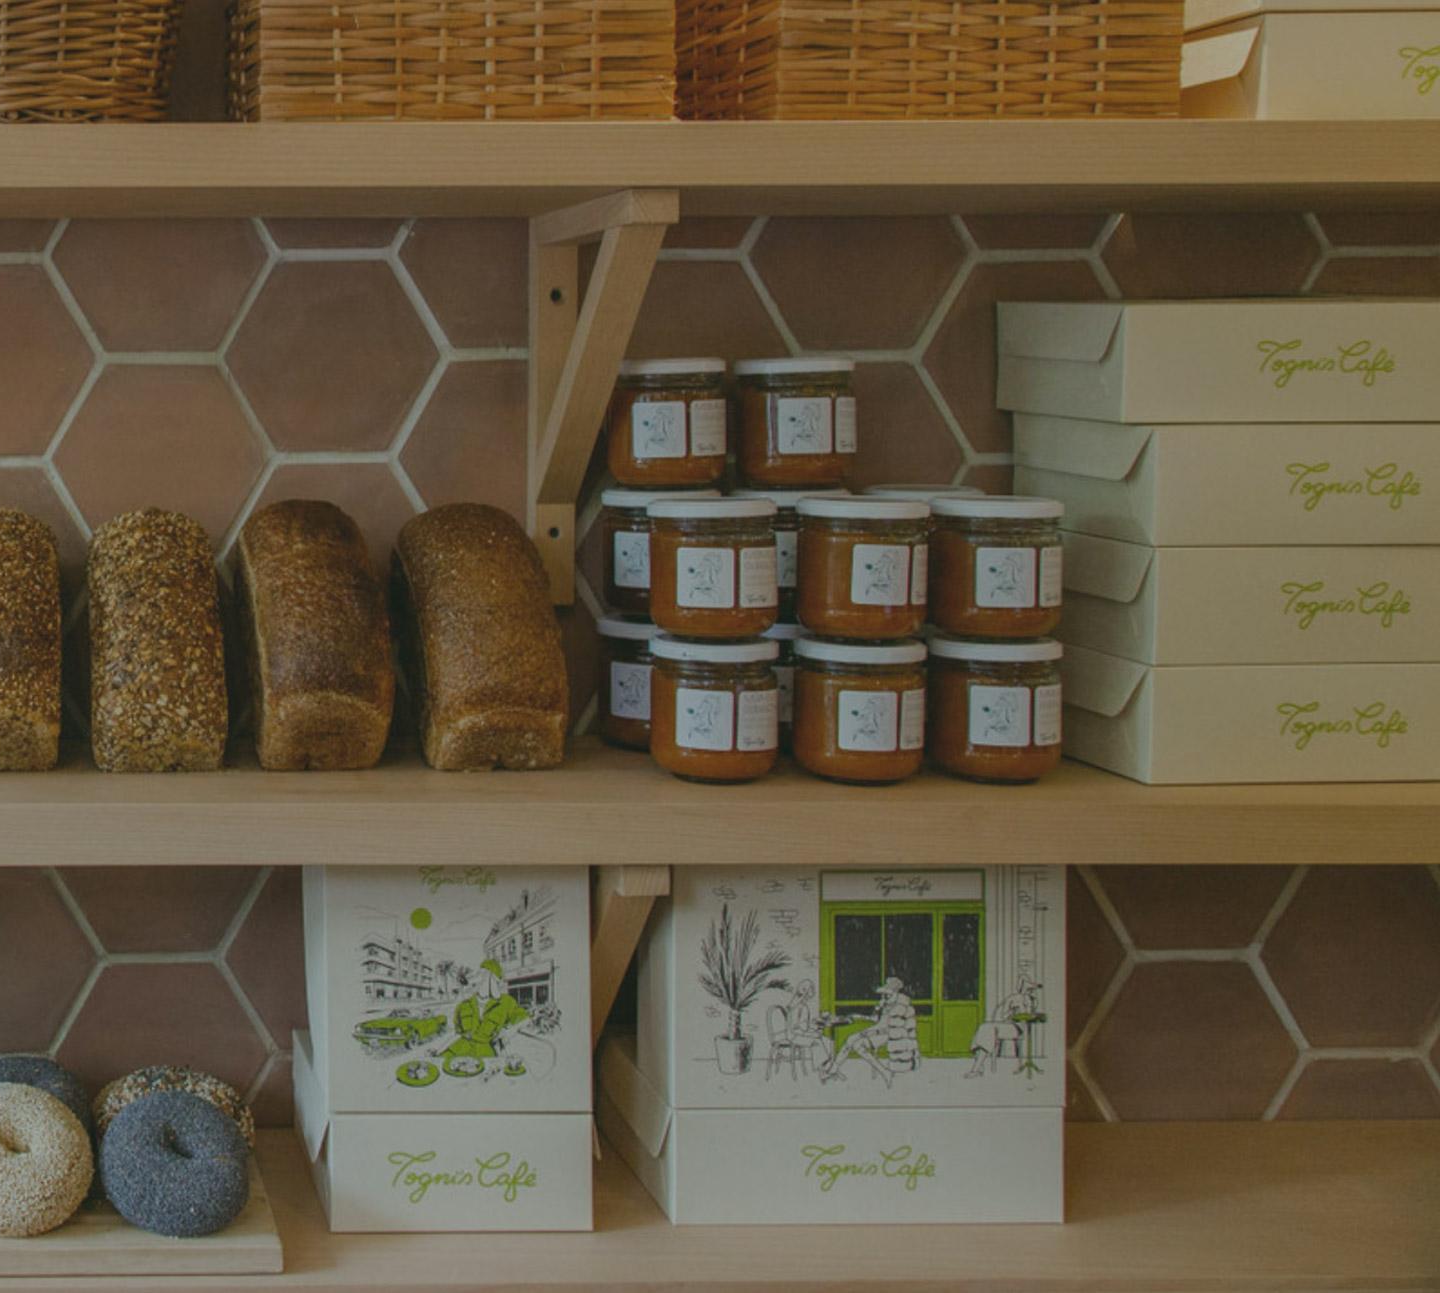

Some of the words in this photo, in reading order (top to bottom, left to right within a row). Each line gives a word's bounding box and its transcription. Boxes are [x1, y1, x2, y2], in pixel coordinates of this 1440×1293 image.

[1338, 339, 1396, 388] Café
[1365, 462, 1421, 512] Café
[1356, 581, 1411, 629] Café
[1354, 701, 1409, 749] Café
[474, 1151, 538, 1203] Café
[879, 1144, 937, 1191] Café
